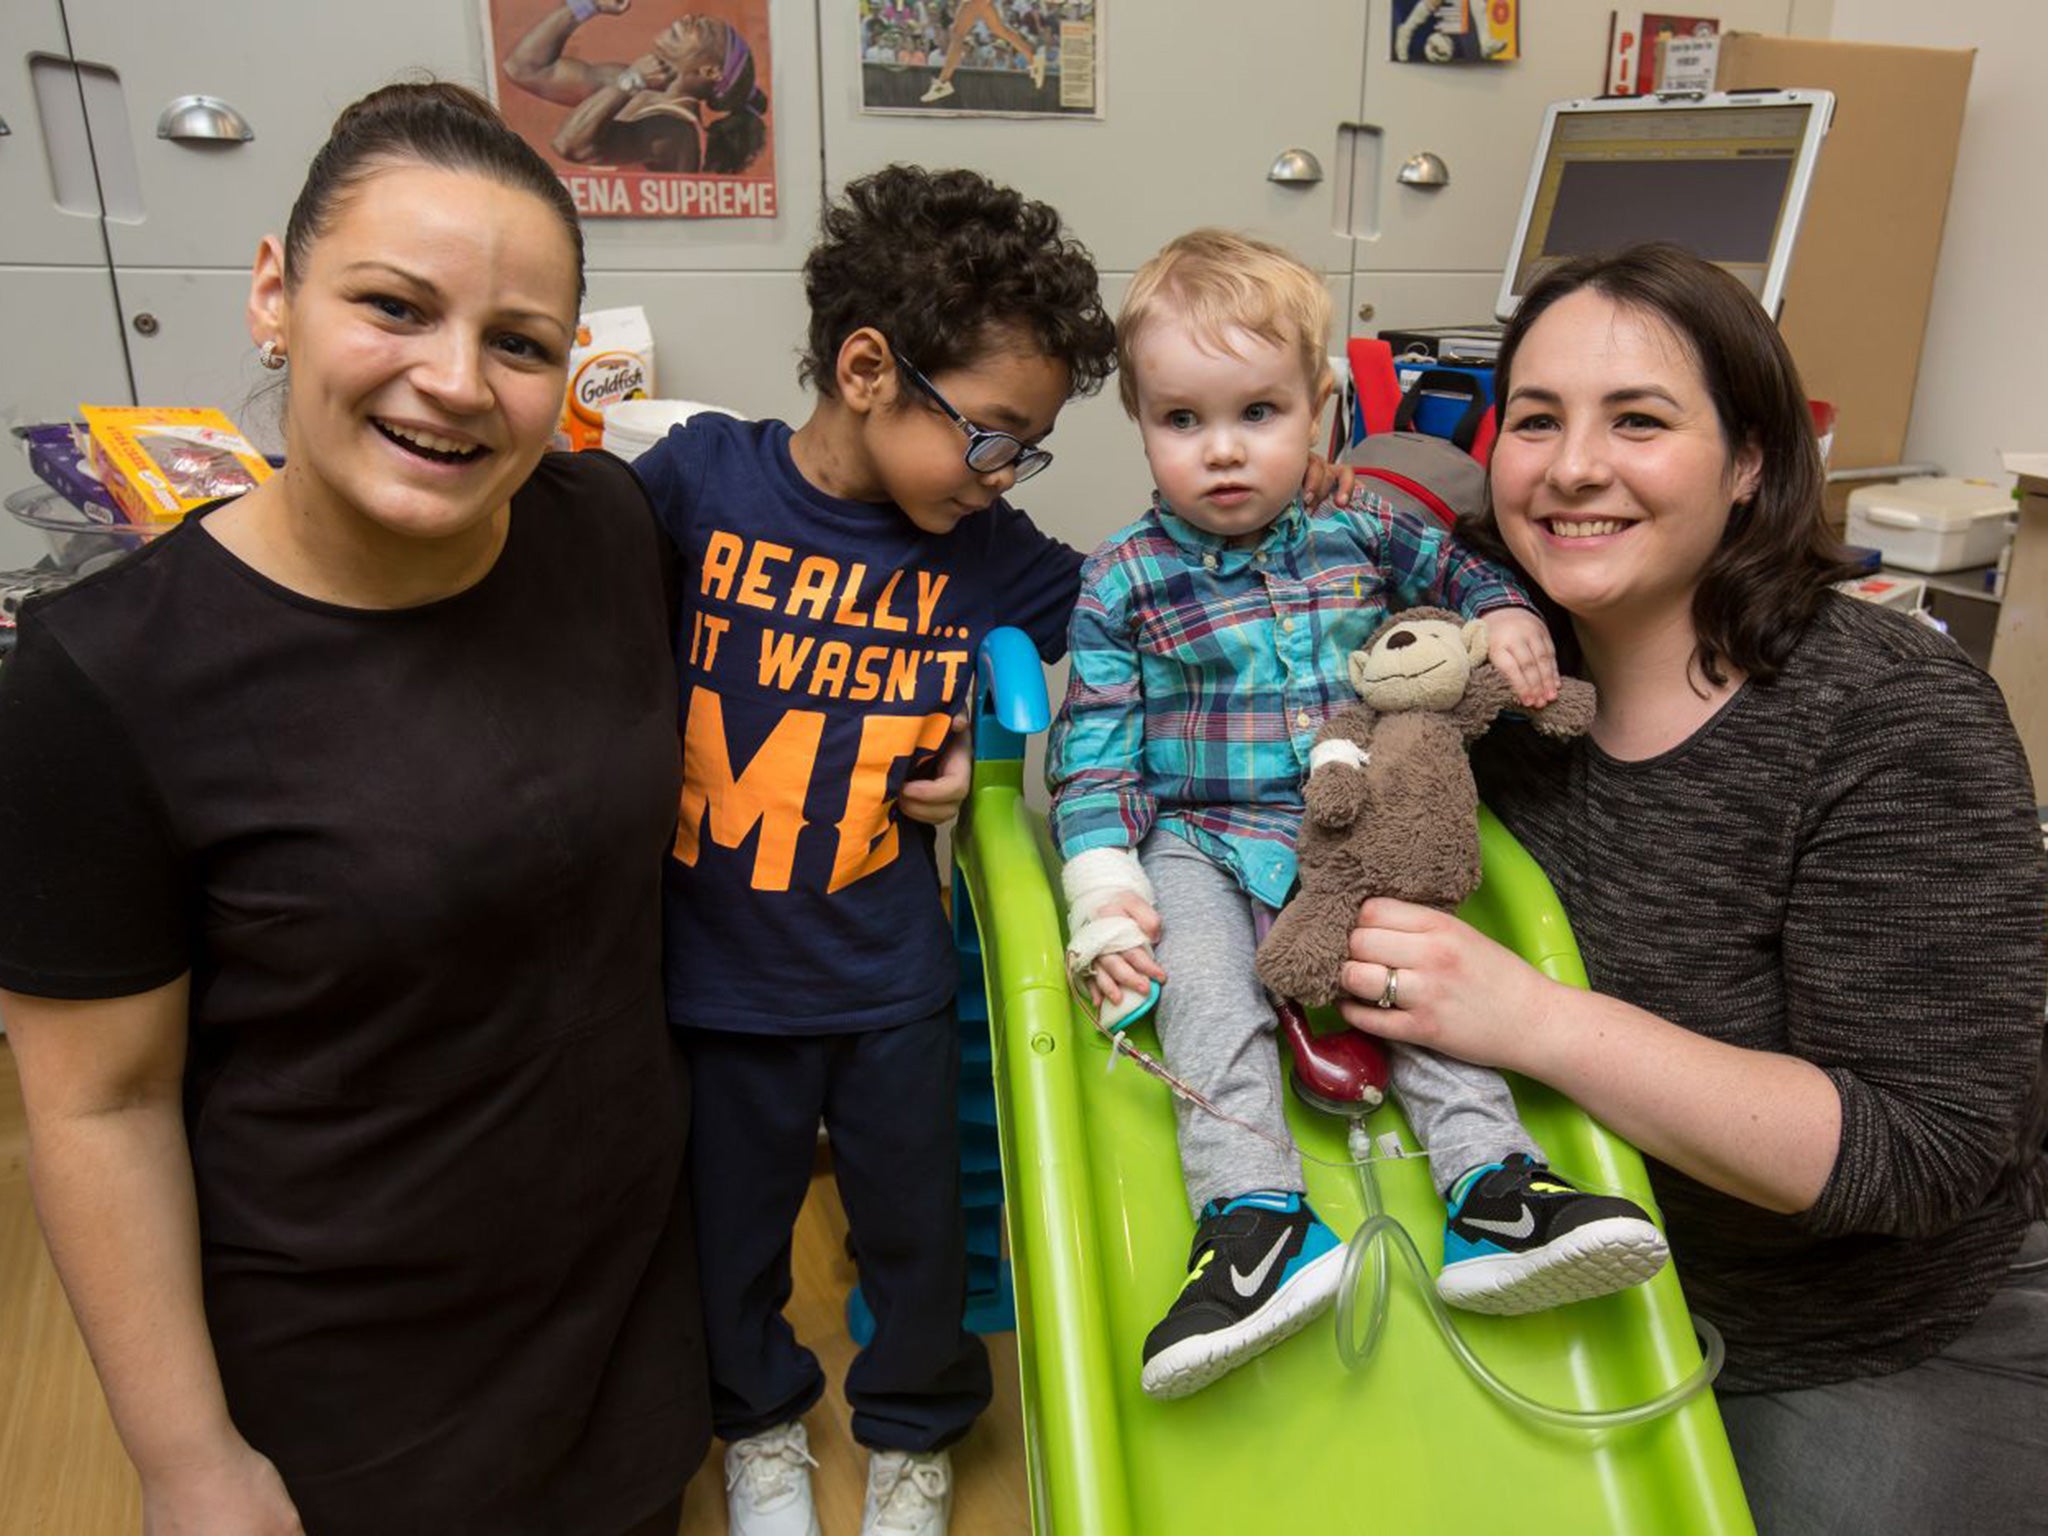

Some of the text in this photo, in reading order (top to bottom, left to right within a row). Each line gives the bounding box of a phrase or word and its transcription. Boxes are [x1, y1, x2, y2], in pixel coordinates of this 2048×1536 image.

[567, 176, 775, 216] ENA SUPREME
[581, 367, 643, 404] Goldfish
[700, 529, 968, 640] REALLY...
[689, 610, 968, 702] IT WASN'T
[672, 684, 952, 894] ME
